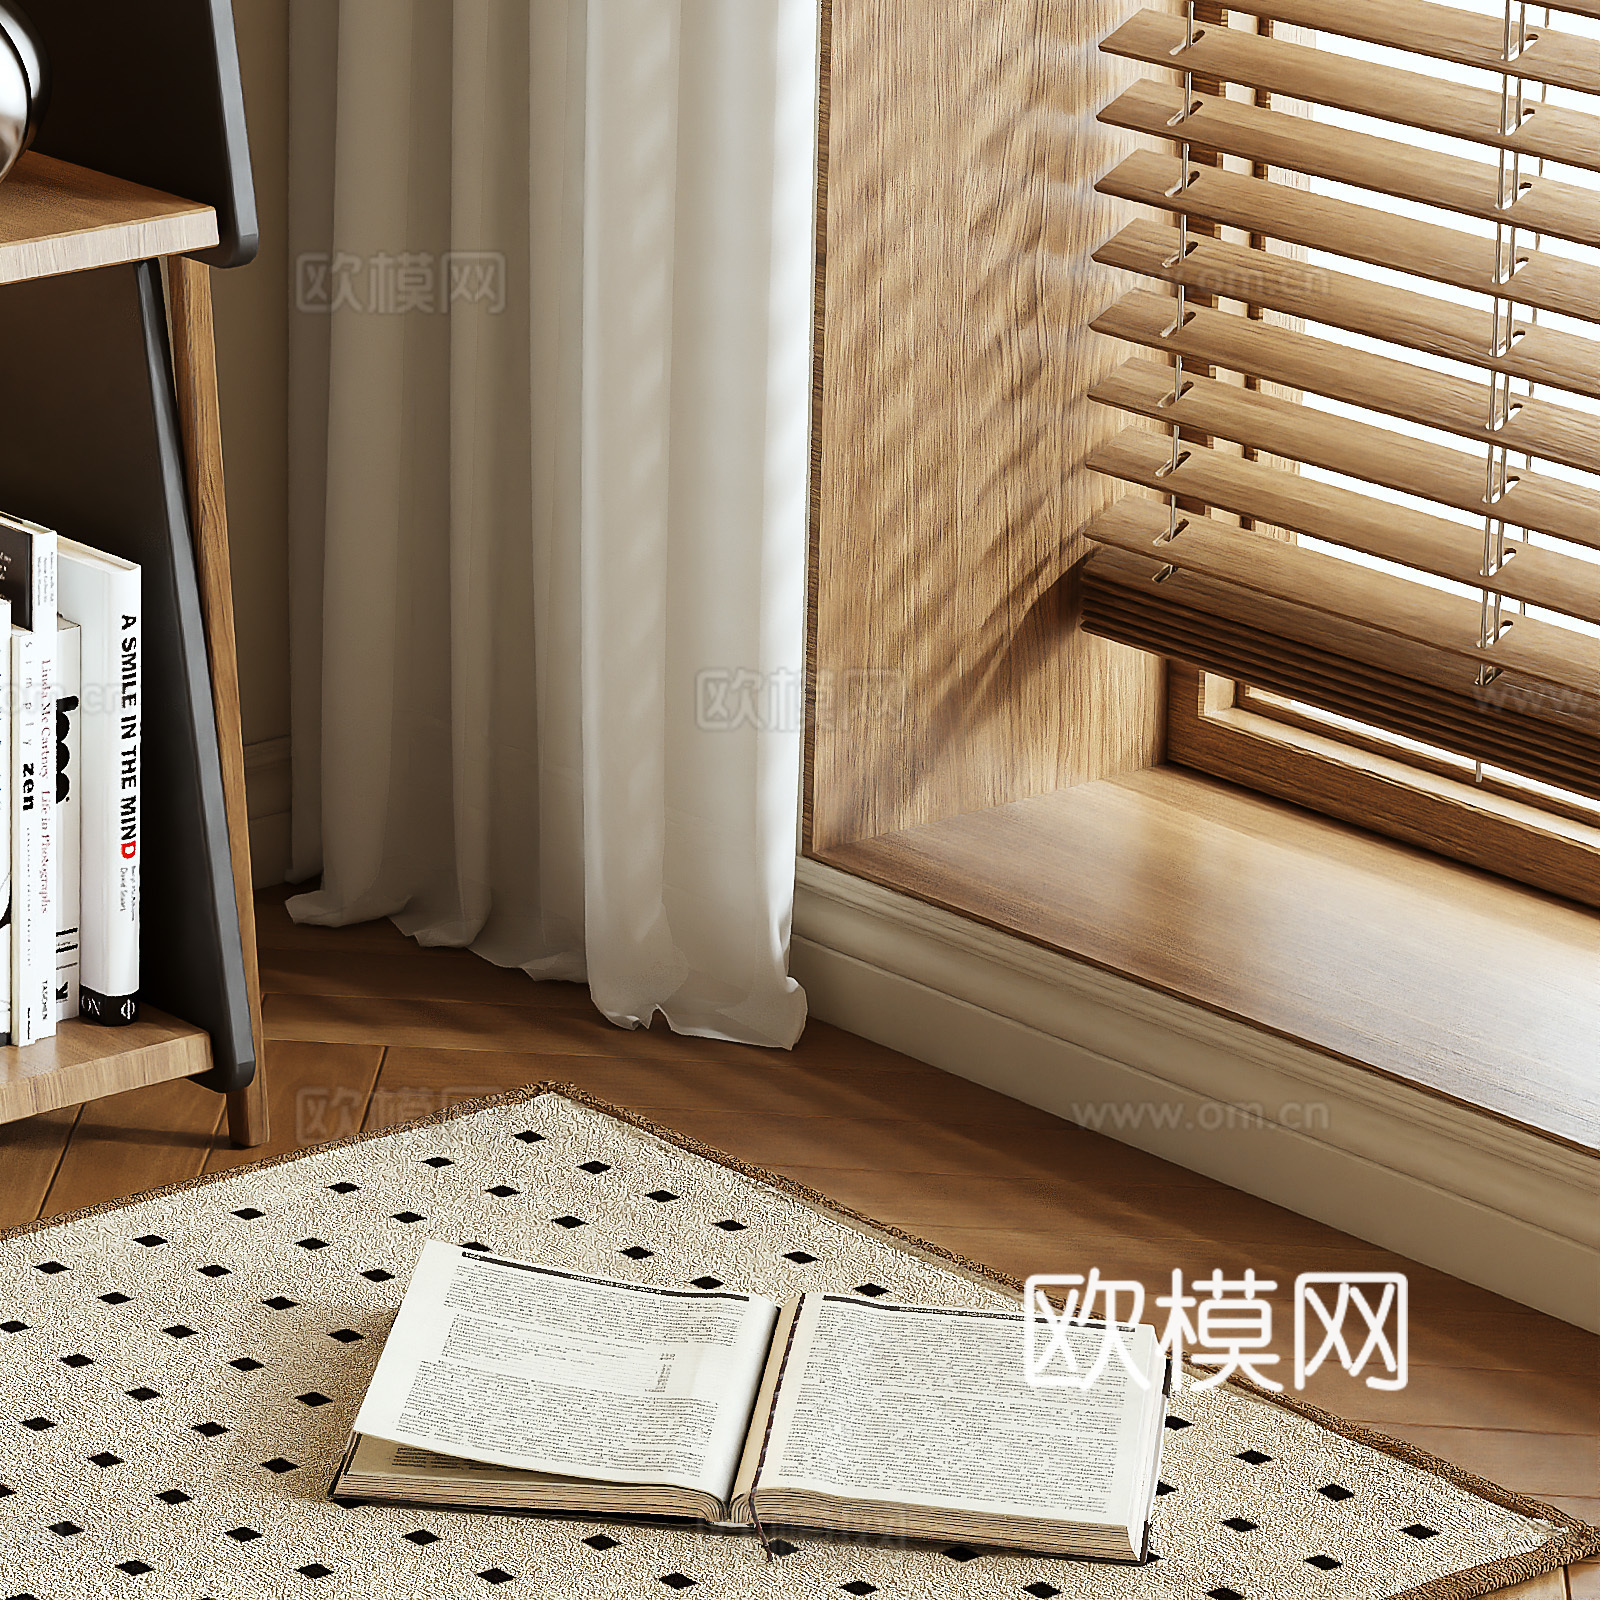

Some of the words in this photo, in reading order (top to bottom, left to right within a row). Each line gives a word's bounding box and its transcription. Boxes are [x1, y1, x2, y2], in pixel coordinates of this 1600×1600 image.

[121, 614, 137, 630] A
[41, 658, 51, 698] Linda
[121, 636, 137, 709] SMILE
[121, 714, 137, 740] IN
[22, 763, 35, 811] zen
[121, 745, 137, 790] THE
[41, 790, 51, 814] Life
[41, 817, 51, 831] in
[120, 796, 137, 860] MIND
[39, 834, 51, 914] Photographs
